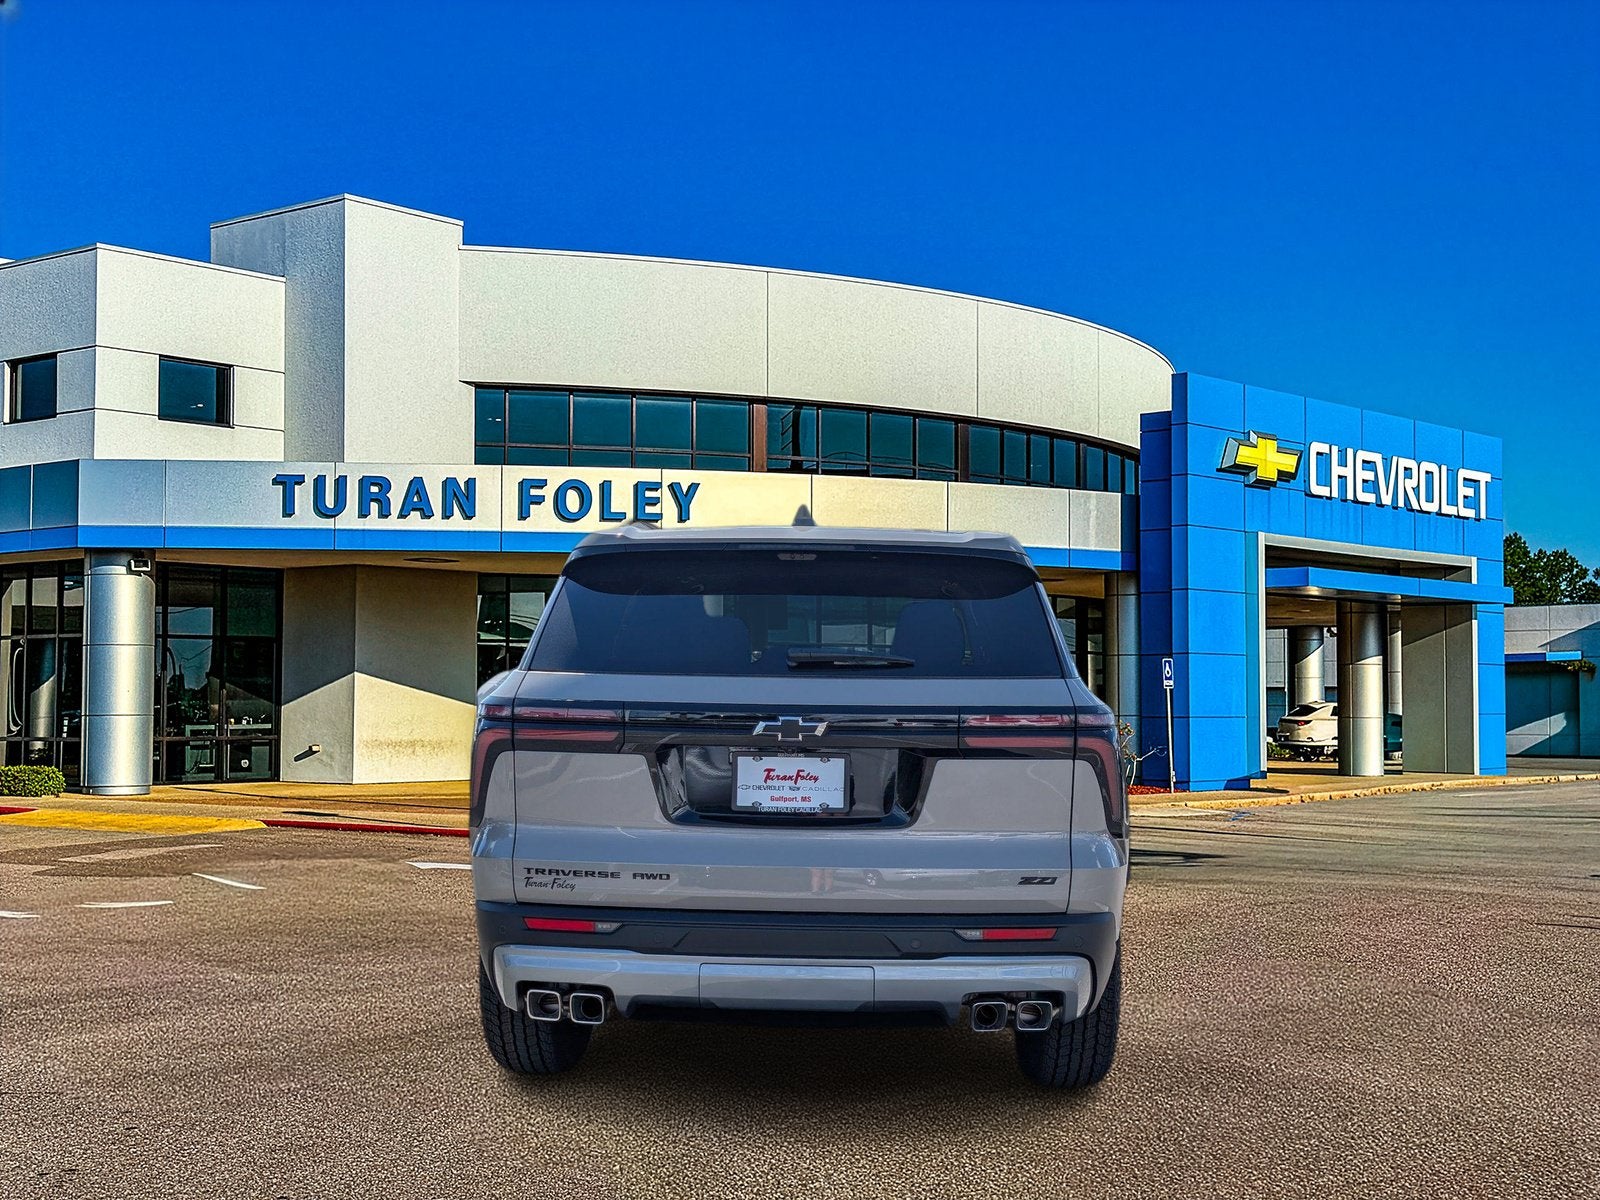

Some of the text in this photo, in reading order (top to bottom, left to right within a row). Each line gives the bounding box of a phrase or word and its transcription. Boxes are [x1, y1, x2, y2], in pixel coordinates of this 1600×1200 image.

[1306, 440, 1492, 520] CHEVROLET
[271, 473, 701, 524] TURAN FOLEY
[763, 768, 819, 785] Turan Foley
[524, 867, 621, 879] TRAVERSE
